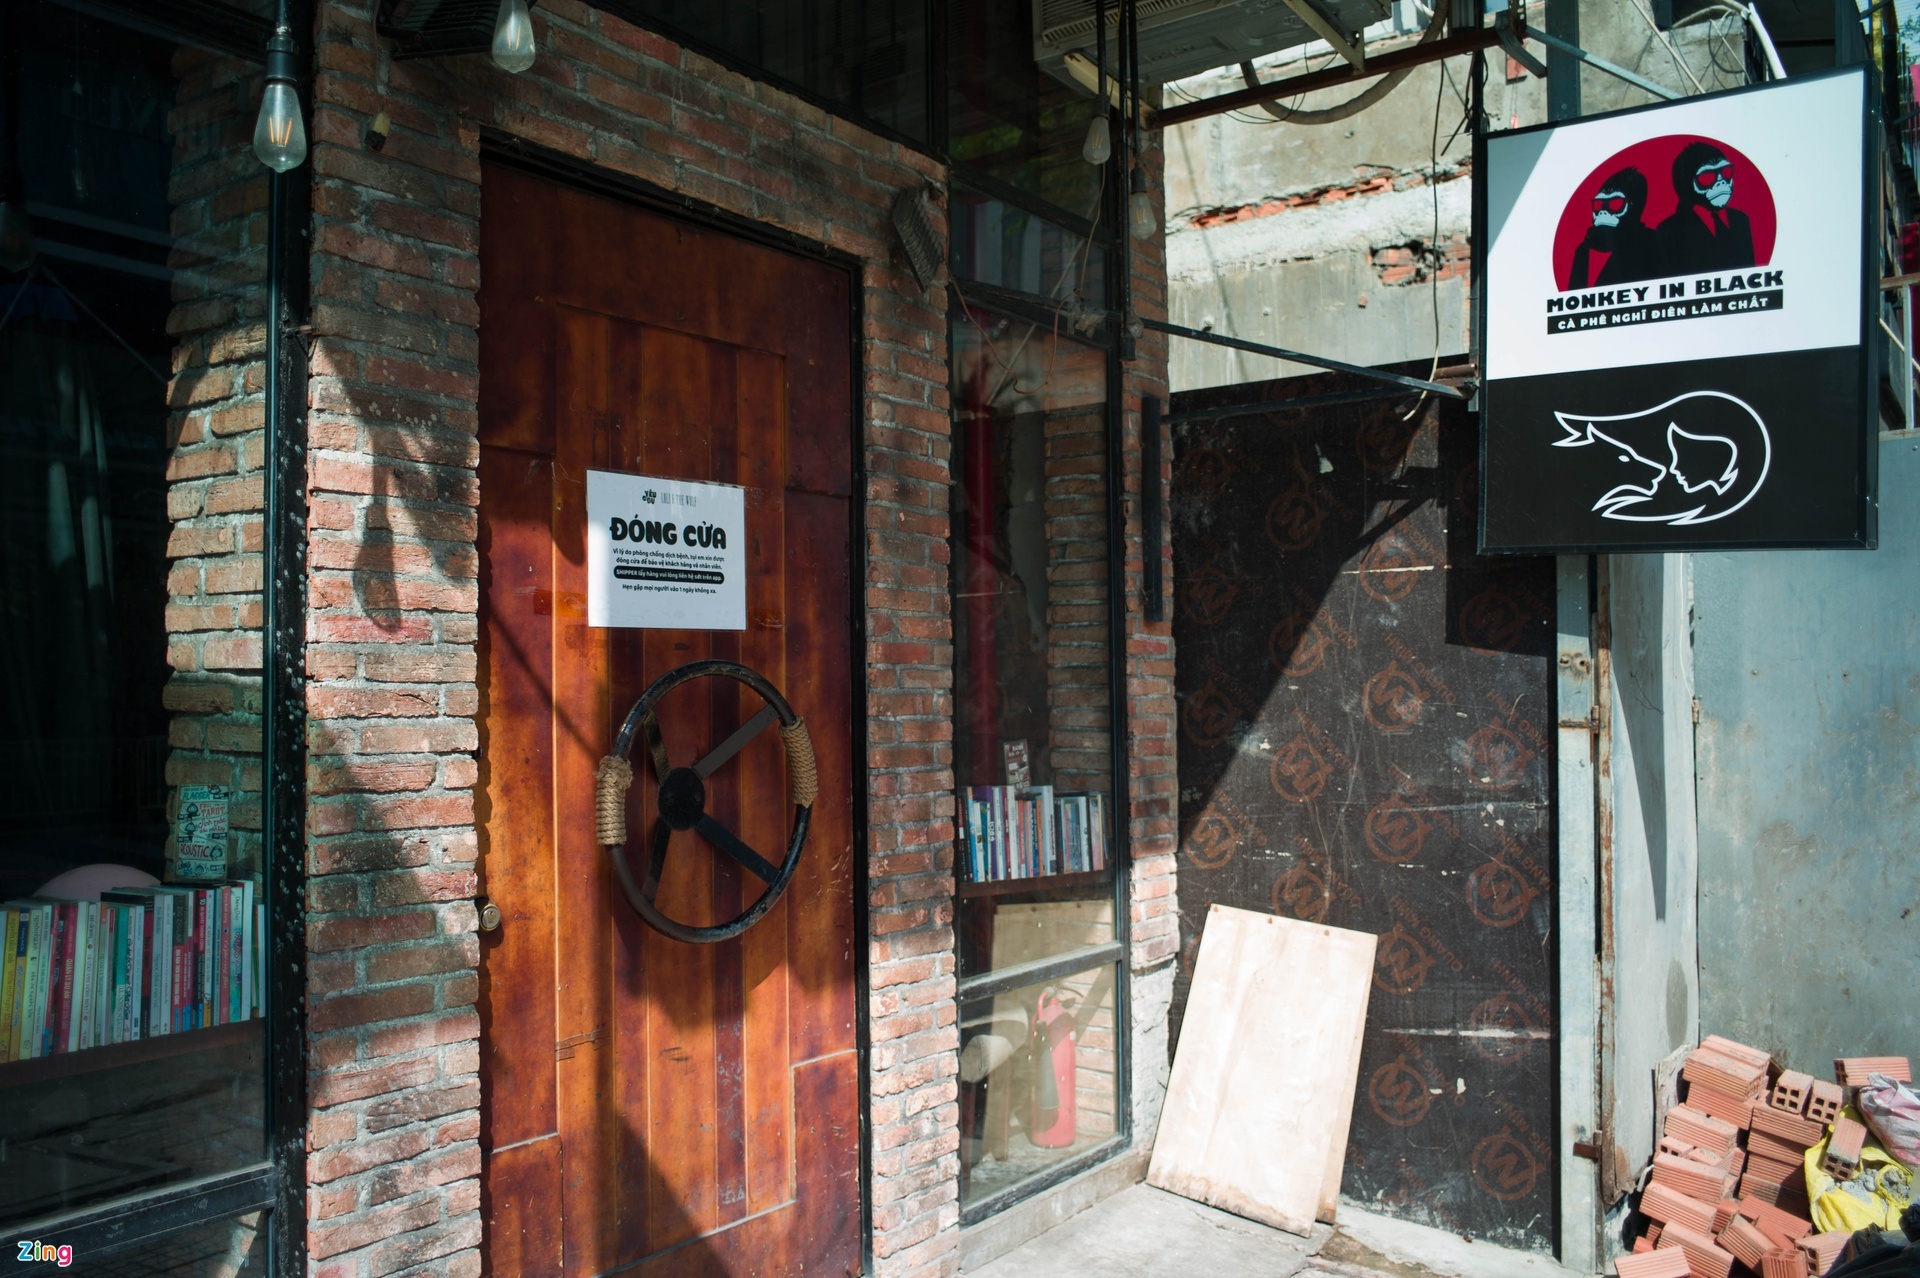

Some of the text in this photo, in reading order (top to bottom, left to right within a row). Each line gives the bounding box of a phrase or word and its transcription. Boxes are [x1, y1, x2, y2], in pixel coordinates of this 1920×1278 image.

[1547, 270, 1783, 313] MONKEY IN BLACK
[1558, 295, 1769, 330] CÀ PHÊ NGHĨ ĐIÊN LÀM CHẤT
[609, 514, 727, 550] ĐÓNG CỬA
